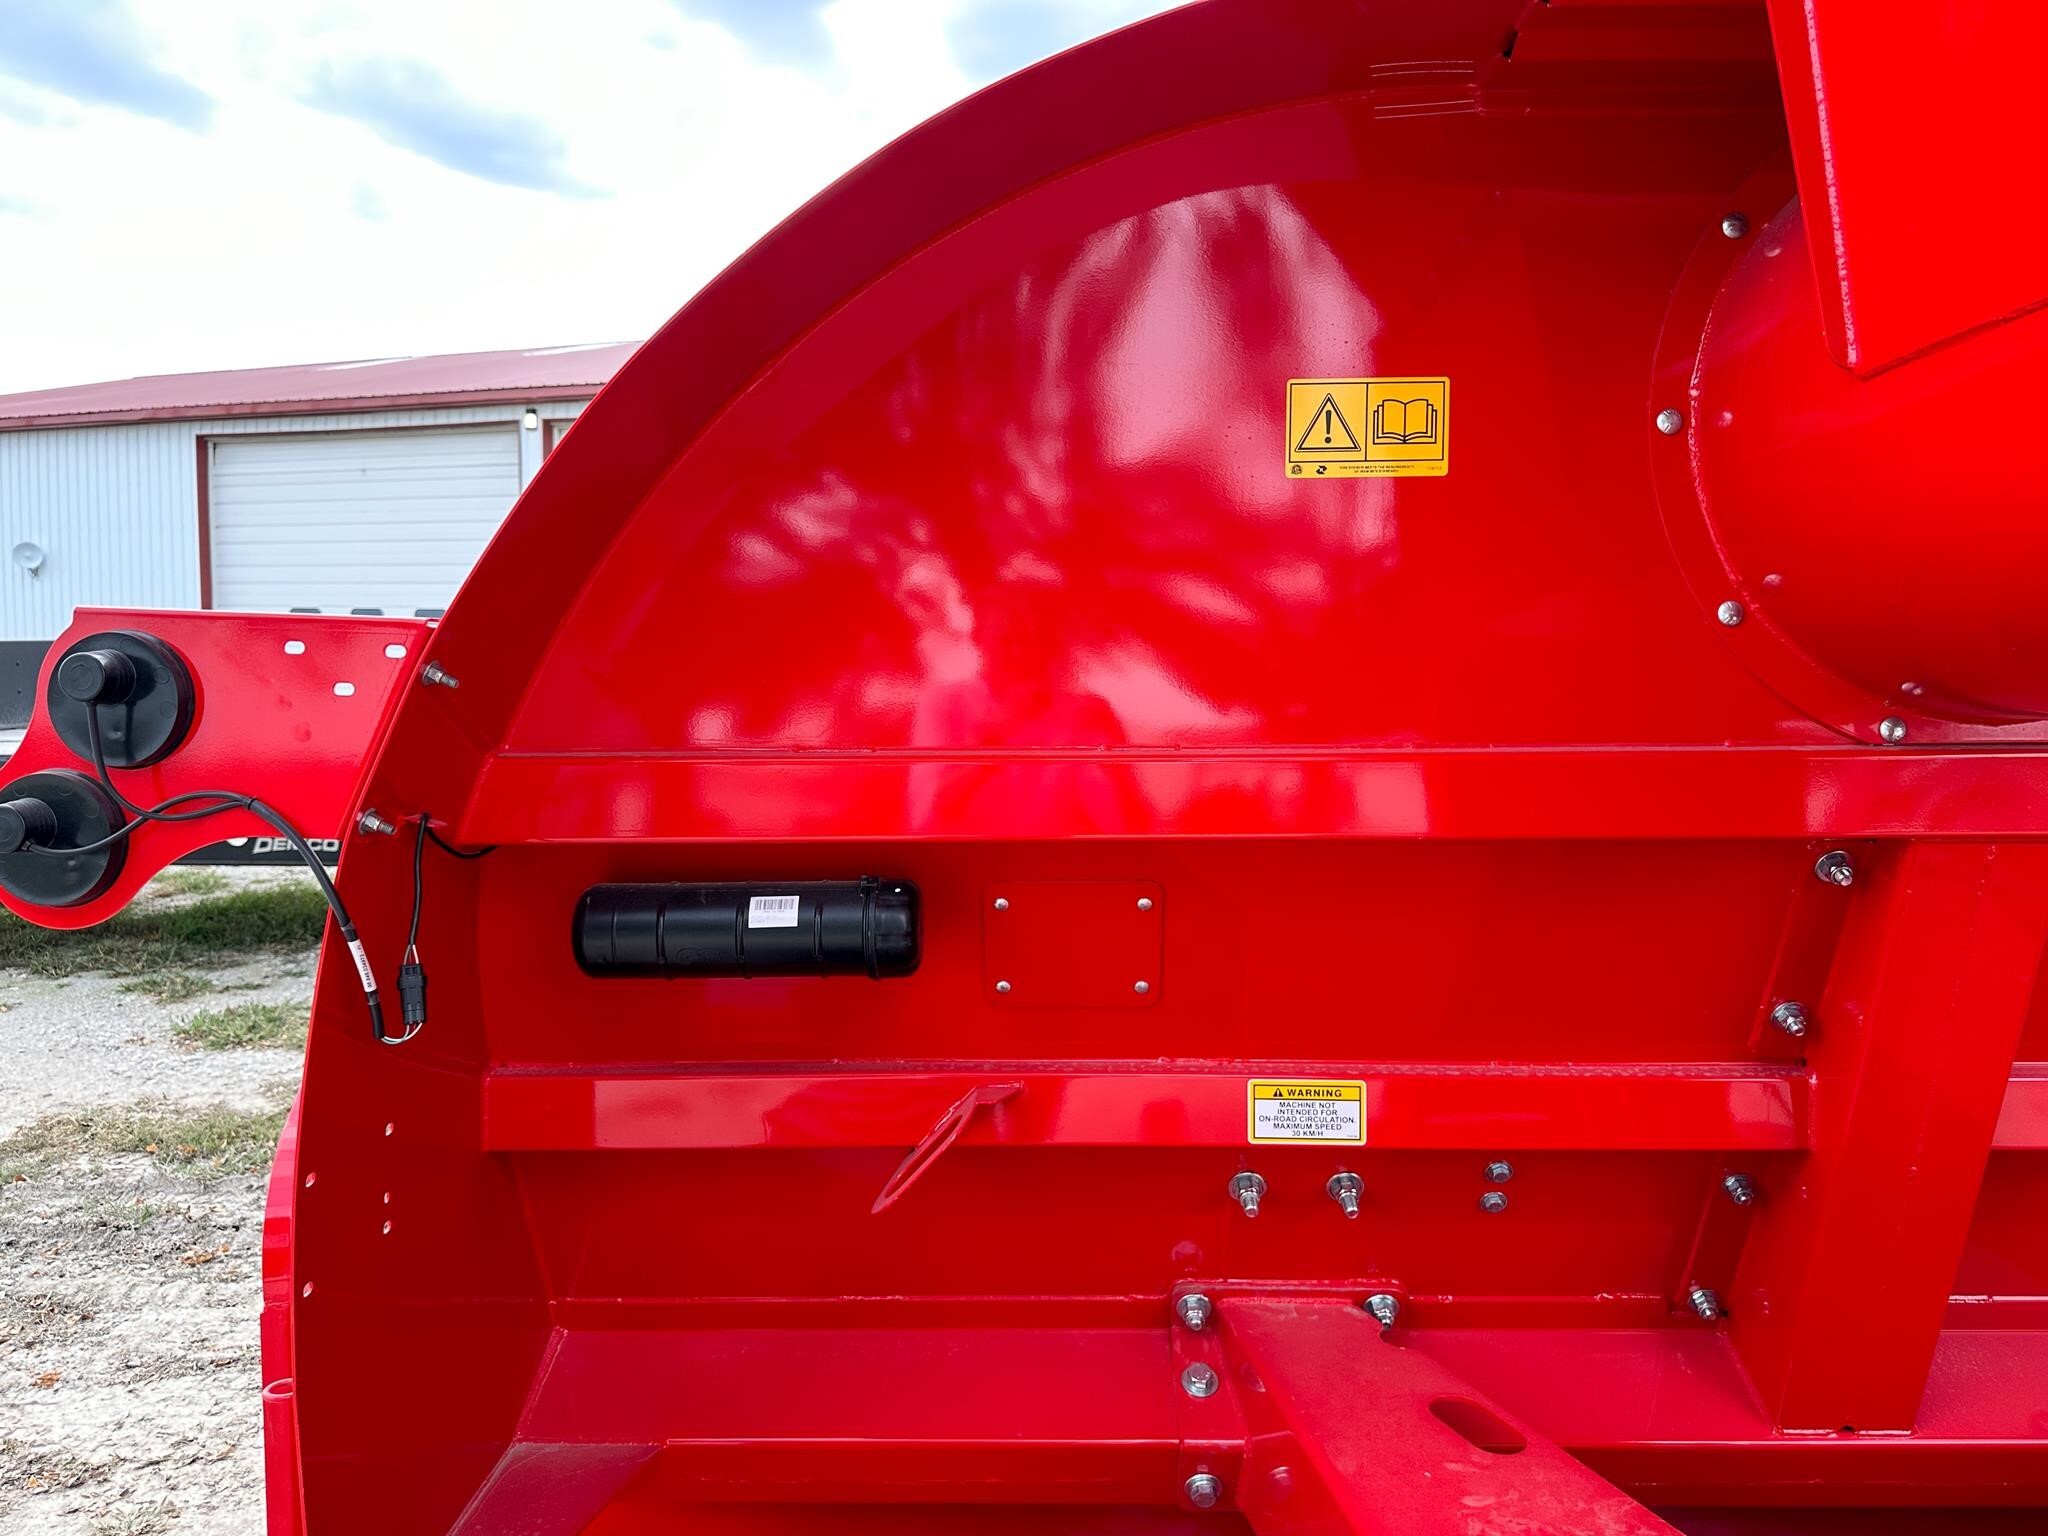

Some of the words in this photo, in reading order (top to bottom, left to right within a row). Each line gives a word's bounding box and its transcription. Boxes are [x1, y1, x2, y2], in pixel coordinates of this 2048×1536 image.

[1287, 1089, 1342, 1097] WARNING
[1279, 1101, 1317, 1109] MACHINE
[1314, 1123, 1342, 1131] SPEED
